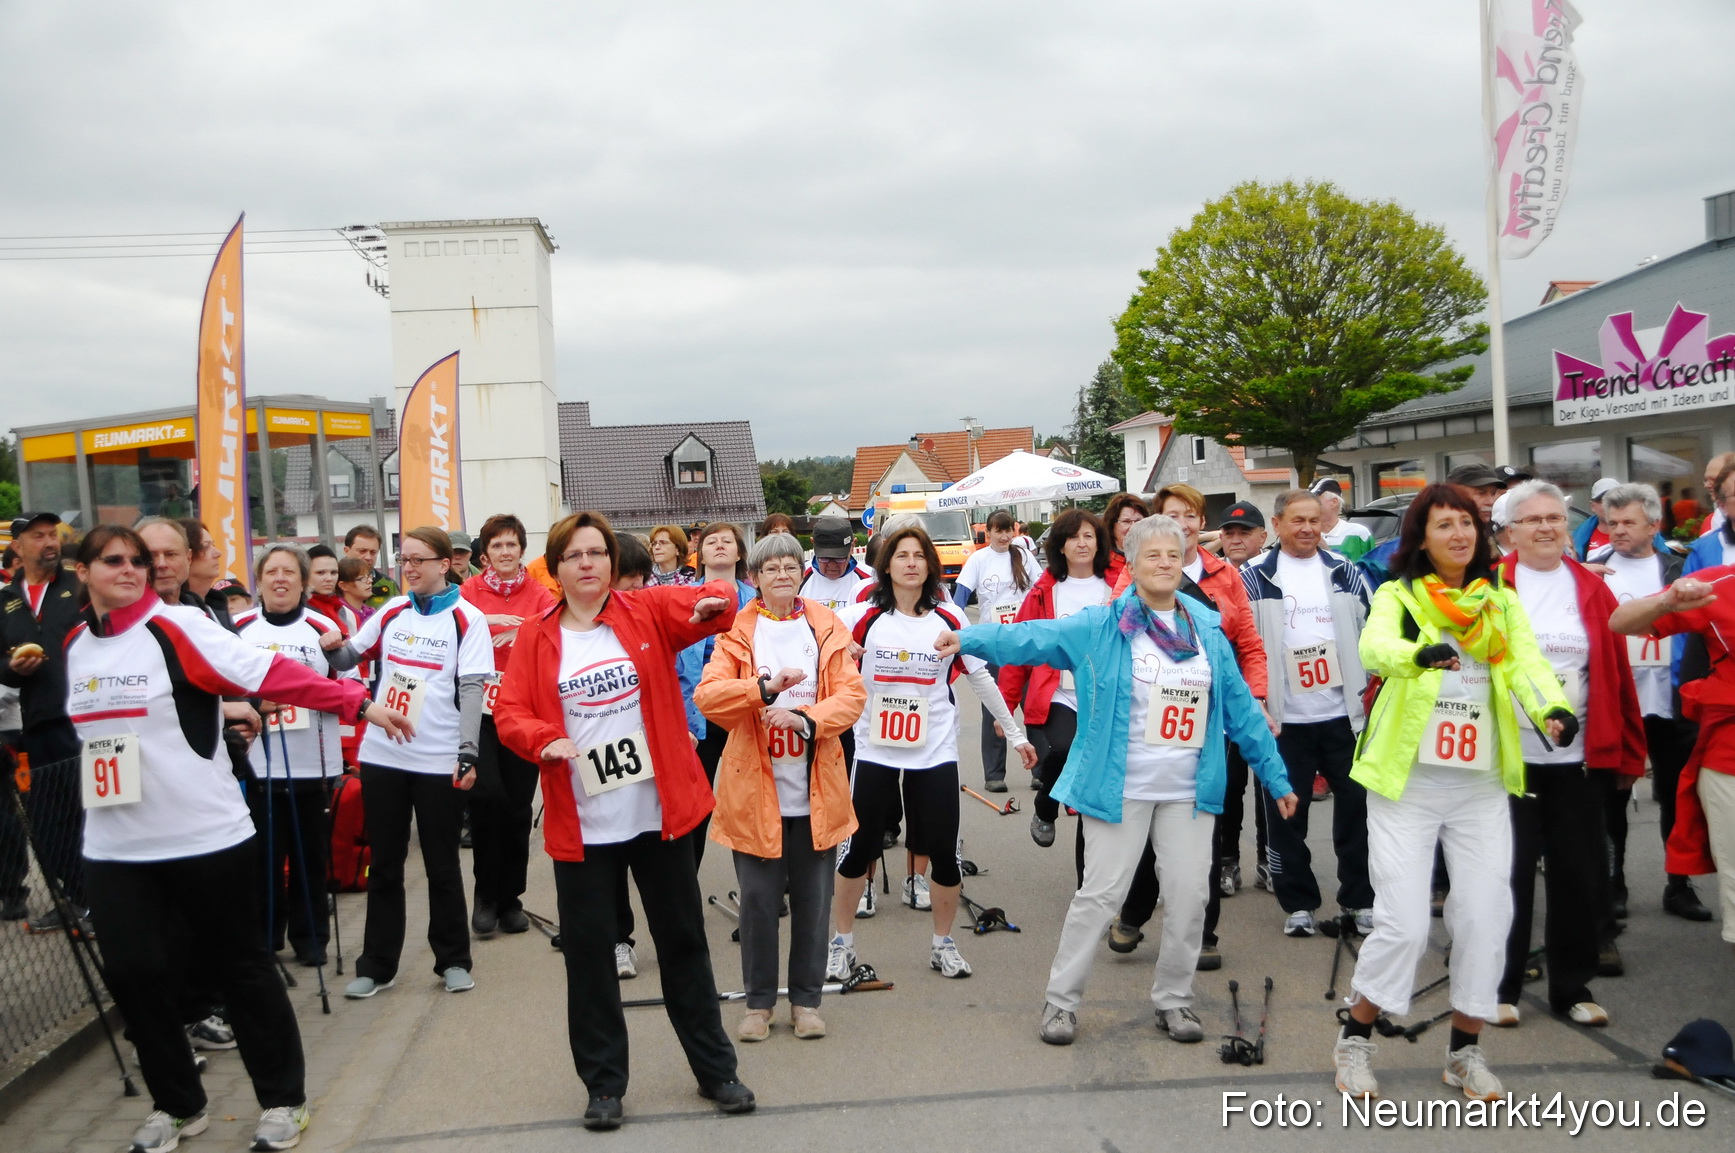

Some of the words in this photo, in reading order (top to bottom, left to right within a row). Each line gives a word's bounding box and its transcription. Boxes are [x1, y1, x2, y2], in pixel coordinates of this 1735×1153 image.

[1564, 361, 1640, 402] Trend
[1560, 408, 1577, 422] Der
[1580, 399, 1646, 422] Kiga-Versand
[1651, 397, 1668, 410] mit
[1672, 393, 1705, 407] Ideen
[1709, 386, 1729, 402] und
[1066, 480, 1103, 491] ERDINGER
[938, 496, 969, 507] ERDINGER
[1293, 647, 1318, 656] MEYER
[1133, 665, 1153, 675] Herz
[1161, 665, 1184, 677] Sport
[1298, 657, 1330, 688] 50
[1161, 687, 1190, 697] MEYER
[881, 696, 908, 705] MEYER
[1160, 694, 1190, 703] WERBUNG
[1434, 700, 1468, 712] MEYER
[568, 708, 583, 718] Das
[584, 708, 619, 720] sportliche
[1433, 708, 1468, 718] WERBUNG
[879, 710, 921, 742] 100
[1160, 705, 1196, 741] 65
[88, 739, 112, 750] MEYER
[769, 726, 804, 758] 60
[1435, 720, 1477, 762] 68
[587, 737, 643, 785] 143
[94, 756, 121, 798] 91
